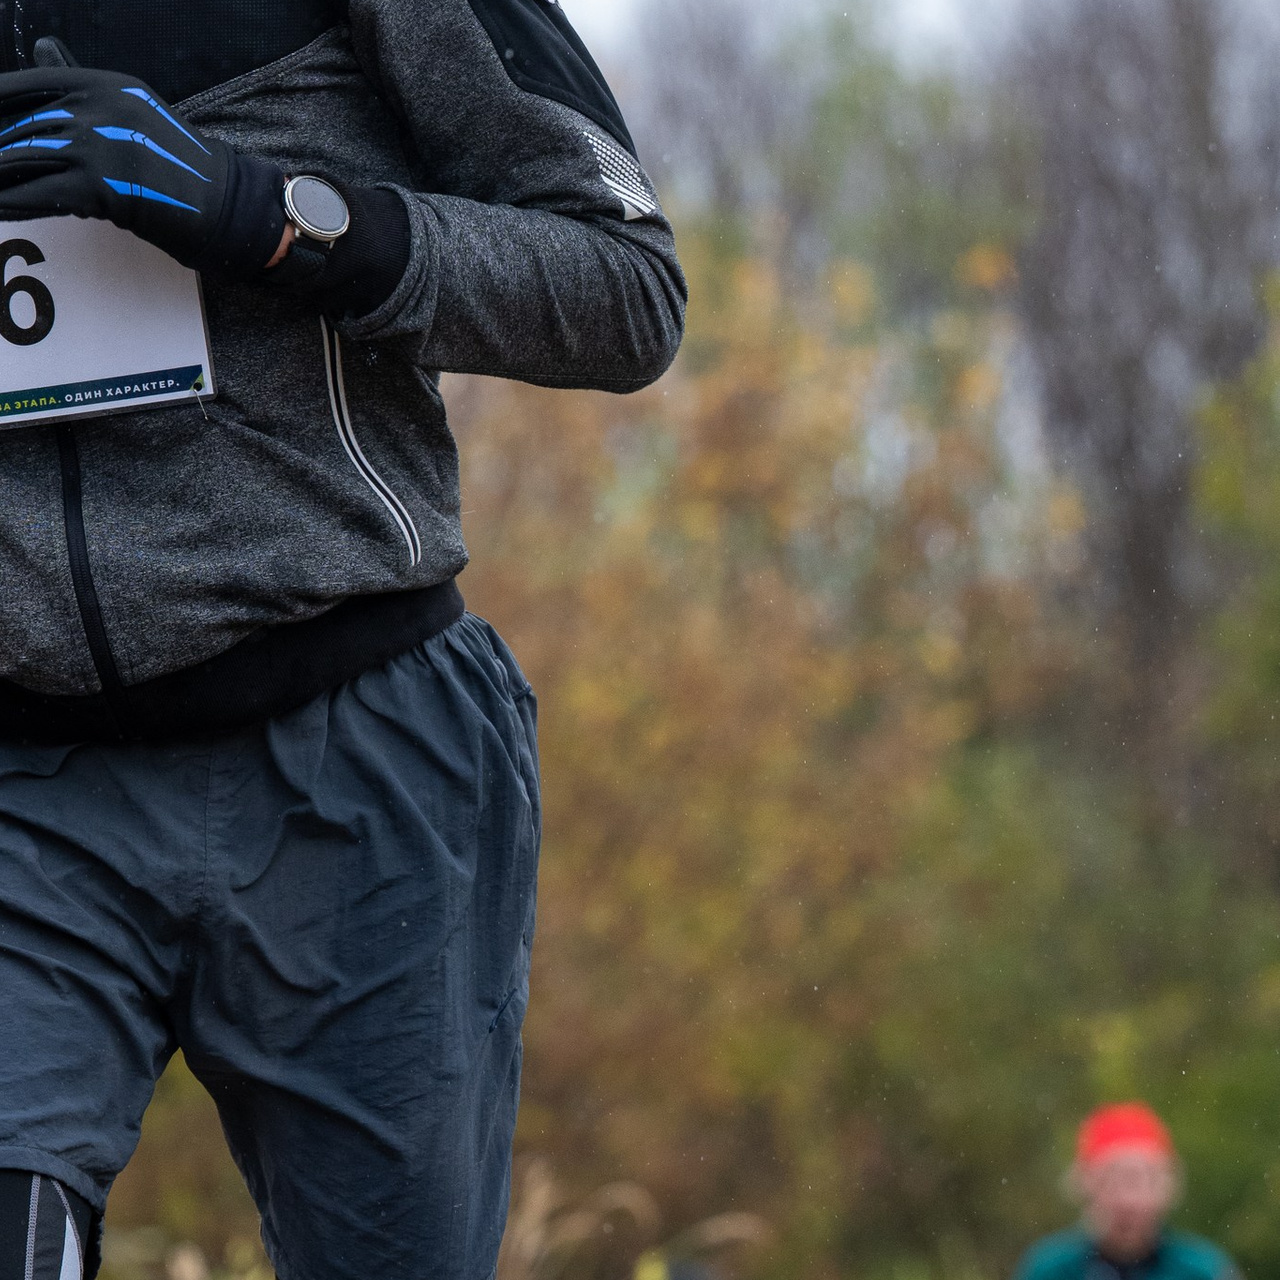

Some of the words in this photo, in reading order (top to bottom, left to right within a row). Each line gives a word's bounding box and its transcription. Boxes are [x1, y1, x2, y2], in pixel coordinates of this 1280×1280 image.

[14, 396, 62, 409] ЭТАПА.
[65, 389, 102, 402] ОДИН
[106, 379, 180, 397] ХАРАКТЕР.
